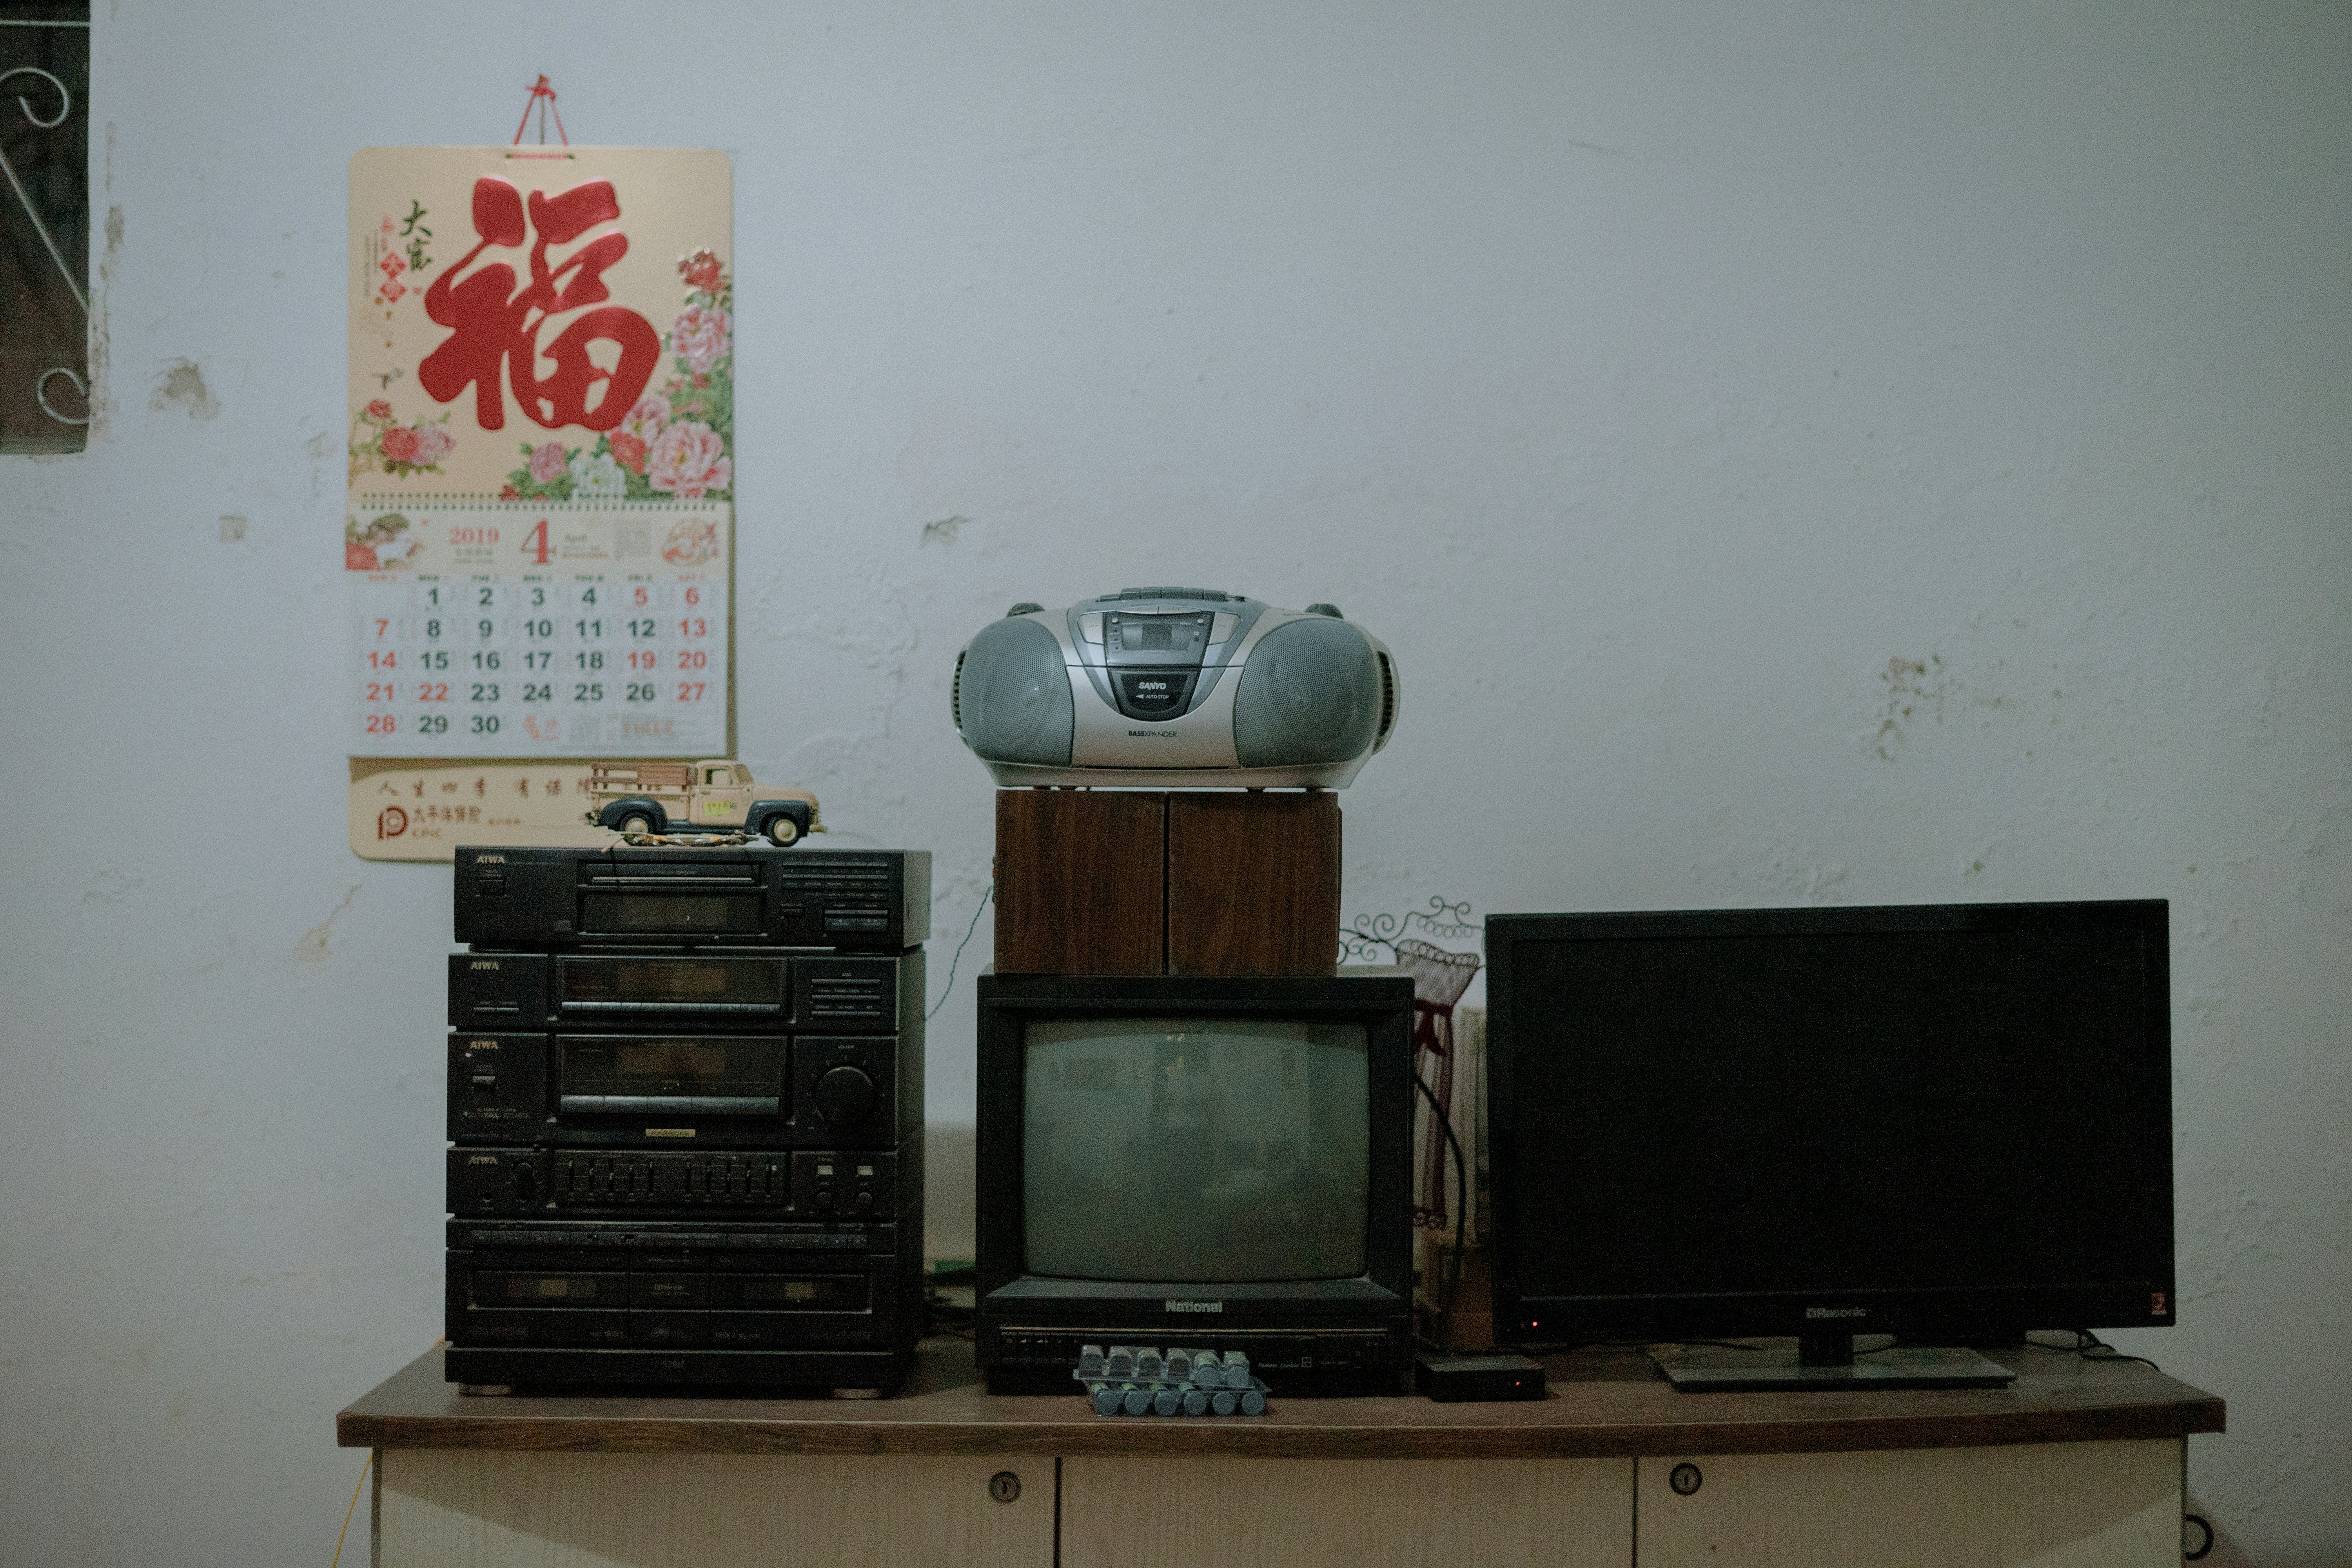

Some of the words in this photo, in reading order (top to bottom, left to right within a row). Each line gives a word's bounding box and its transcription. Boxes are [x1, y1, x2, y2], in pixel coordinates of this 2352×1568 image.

[419, 176, 661, 432] 福
[450, 527, 499, 545] 2019
[521, 519, 557, 566] 4
[428, 588, 438, 606] 1
[479, 587, 493, 606] 2
[532, 588, 545, 606] 3
[582, 587, 597, 606] 4
[635, 588, 648, 606] 5
[685, 588, 699, 605] 6
[375, 619, 389, 637] 7
[427, 619, 441, 639] 8
[479, 619, 493, 638] 9
[525, 619, 553, 638] 10
[576, 619, 601, 638] 11
[628, 619, 655, 638] 12
[680, 619, 706, 637] 13
[368, 651, 396, 669] 14
[421, 651, 449, 670] 15
[472, 652, 501, 670] 16
[524, 652, 552, 669] 17
[576, 651, 604, 670] 18
[628, 652, 655, 669] 19
[679, 651, 706, 669] 20
[367, 683, 393, 701] 21
[419, 683, 448, 701] 22
[471, 683, 500, 702] 23
[523, 683, 552, 702] 24
[574, 683, 603, 702] 25
[626, 683, 655, 702] 26
[678, 682, 706, 701] 27
[1138, 682, 1167, 690] SANYO
[367, 715, 396, 733] 28
[419, 715, 449, 734] 29
[471, 715, 500, 734] 30
[471, 962, 499, 970] AIWA
[470, 1041, 499, 1049] AIWA
[469, 1156, 497, 1165] AIWA
[1166, 1301, 1223, 1312] National
